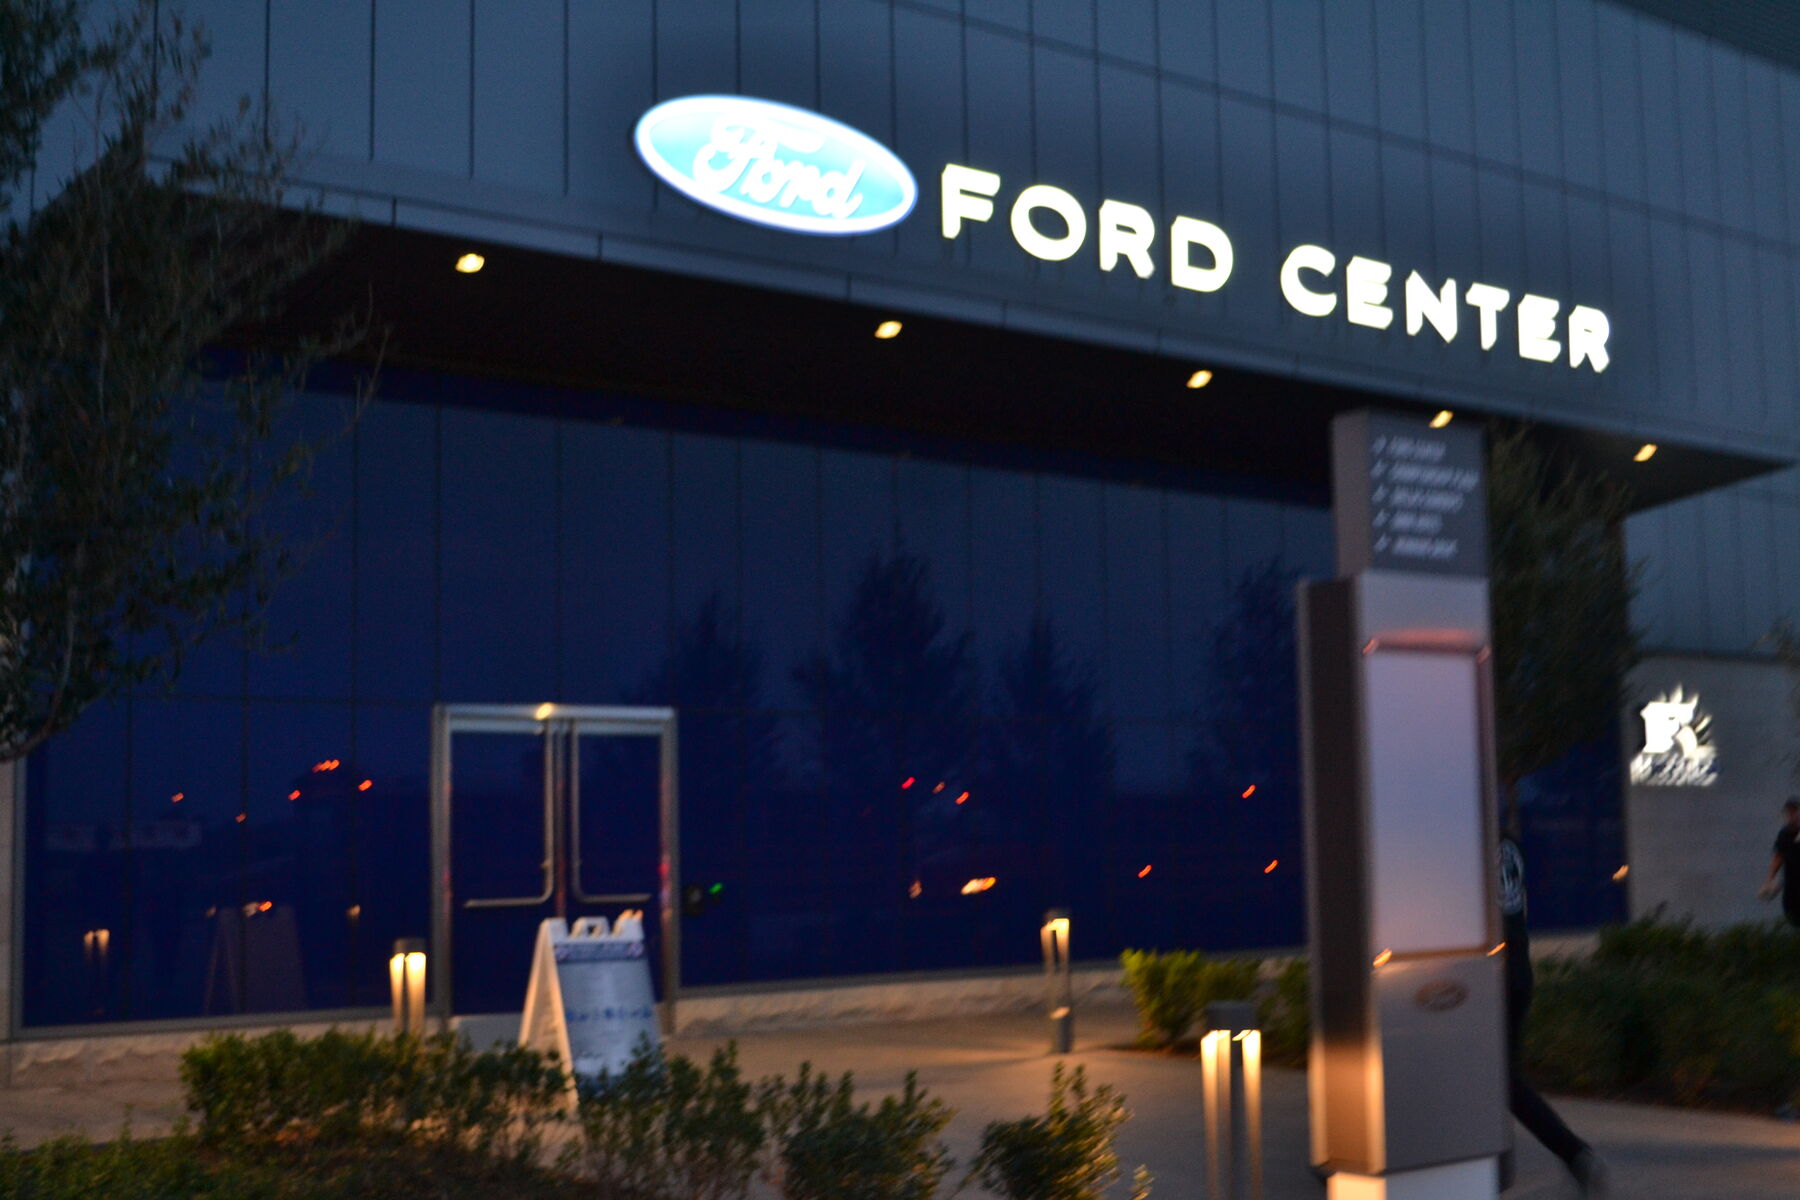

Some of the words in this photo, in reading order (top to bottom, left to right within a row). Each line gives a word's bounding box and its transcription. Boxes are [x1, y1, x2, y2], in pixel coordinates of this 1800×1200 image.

[692, 114, 865, 219] Ford
[941, 163, 1234, 293] FORD
[1280, 244, 1610, 373] CENTER
